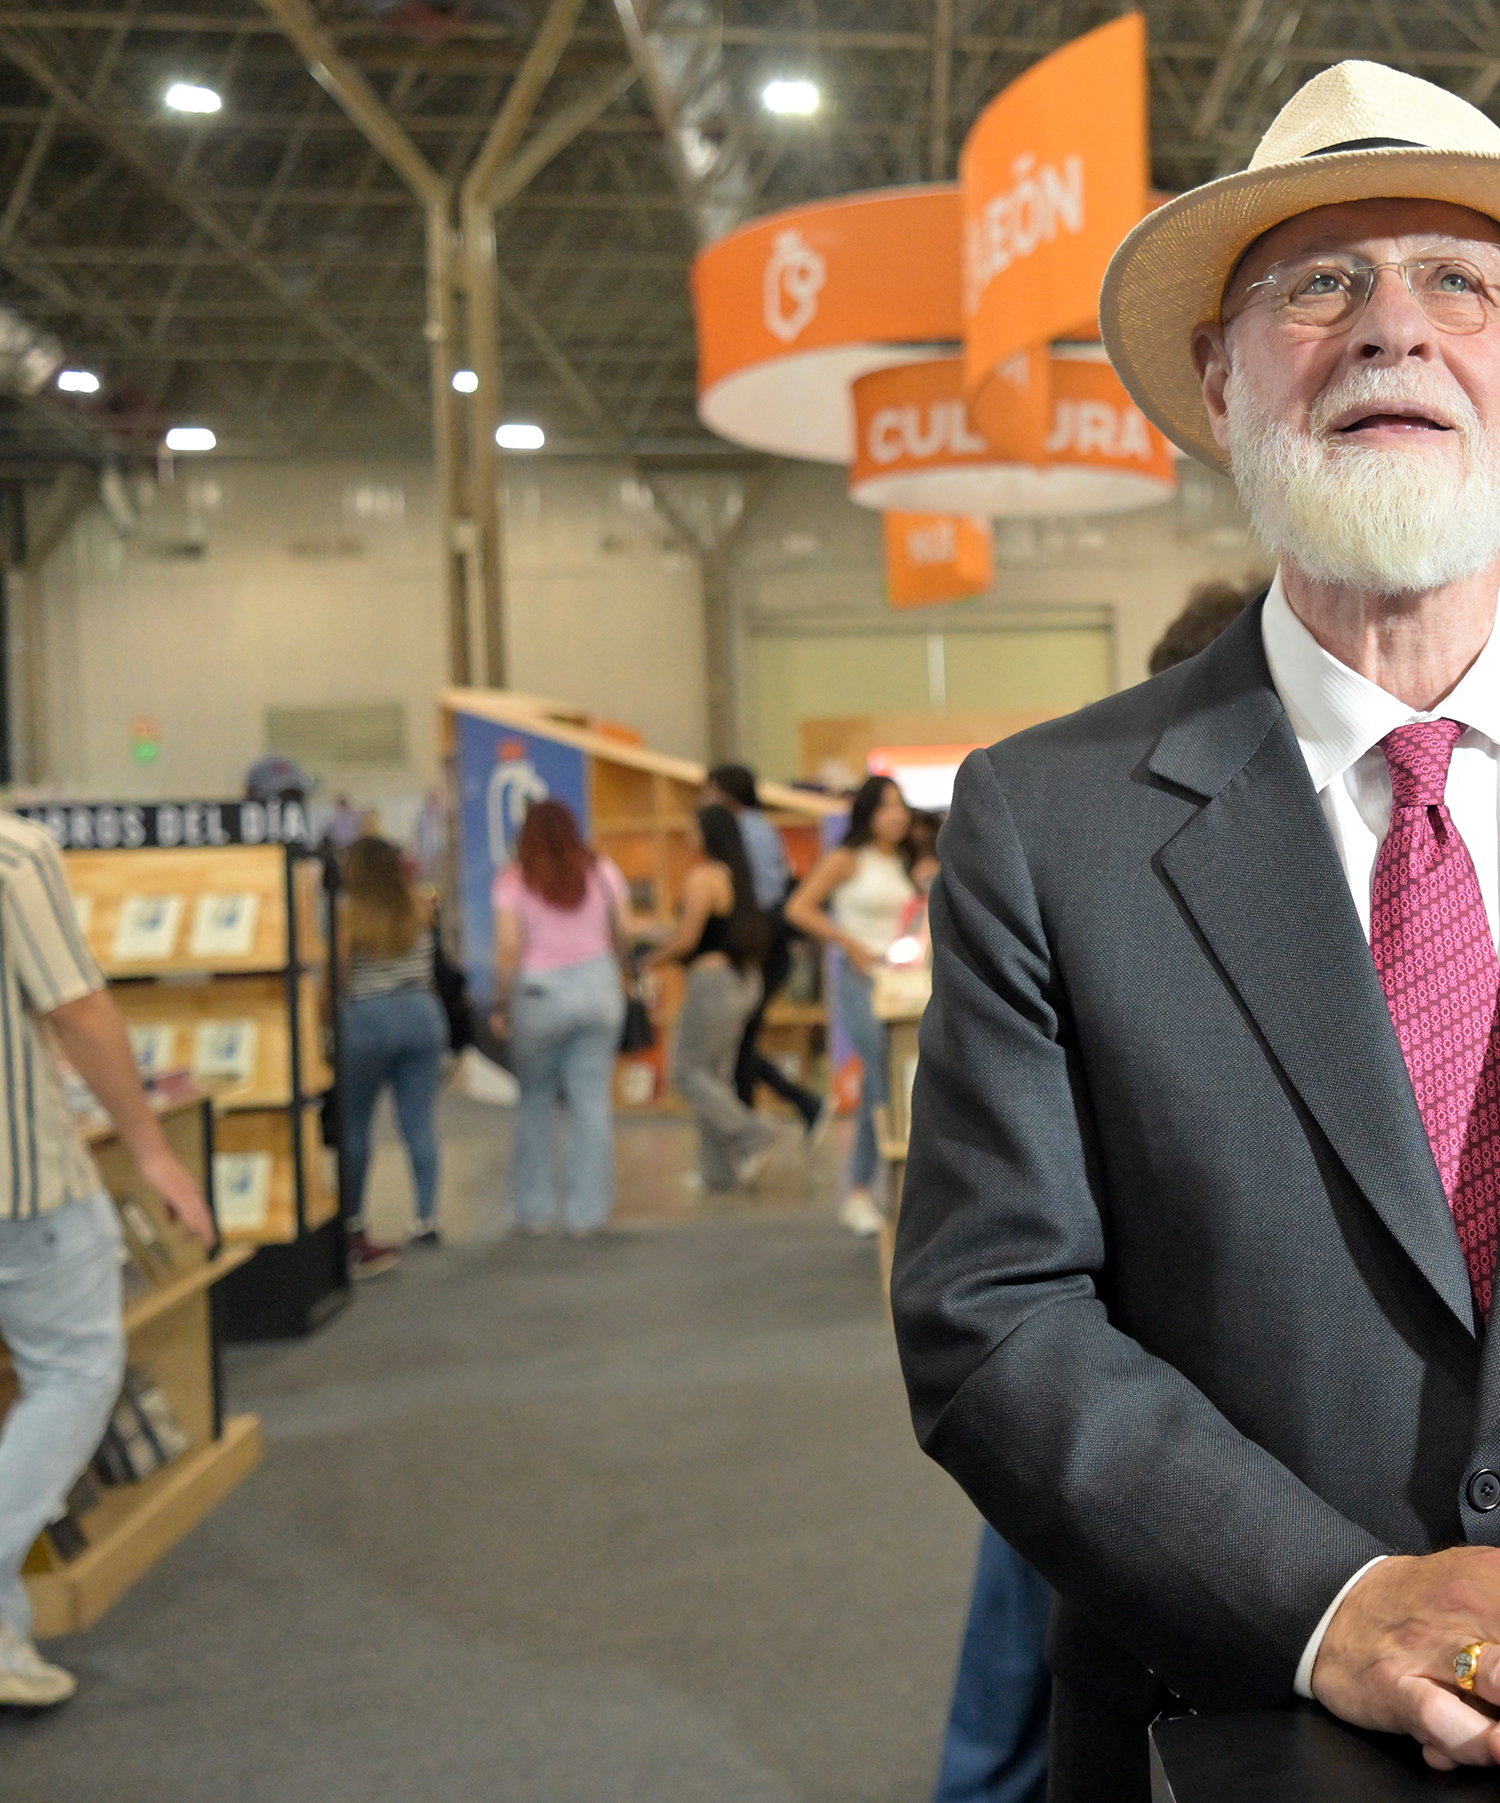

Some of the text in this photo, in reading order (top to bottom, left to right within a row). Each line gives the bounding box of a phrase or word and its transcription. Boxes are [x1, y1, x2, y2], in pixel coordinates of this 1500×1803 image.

[867, 398, 1152, 463] CULURA
[30, 804, 147, 849] BROS
[156, 802, 231, 847] DEL
